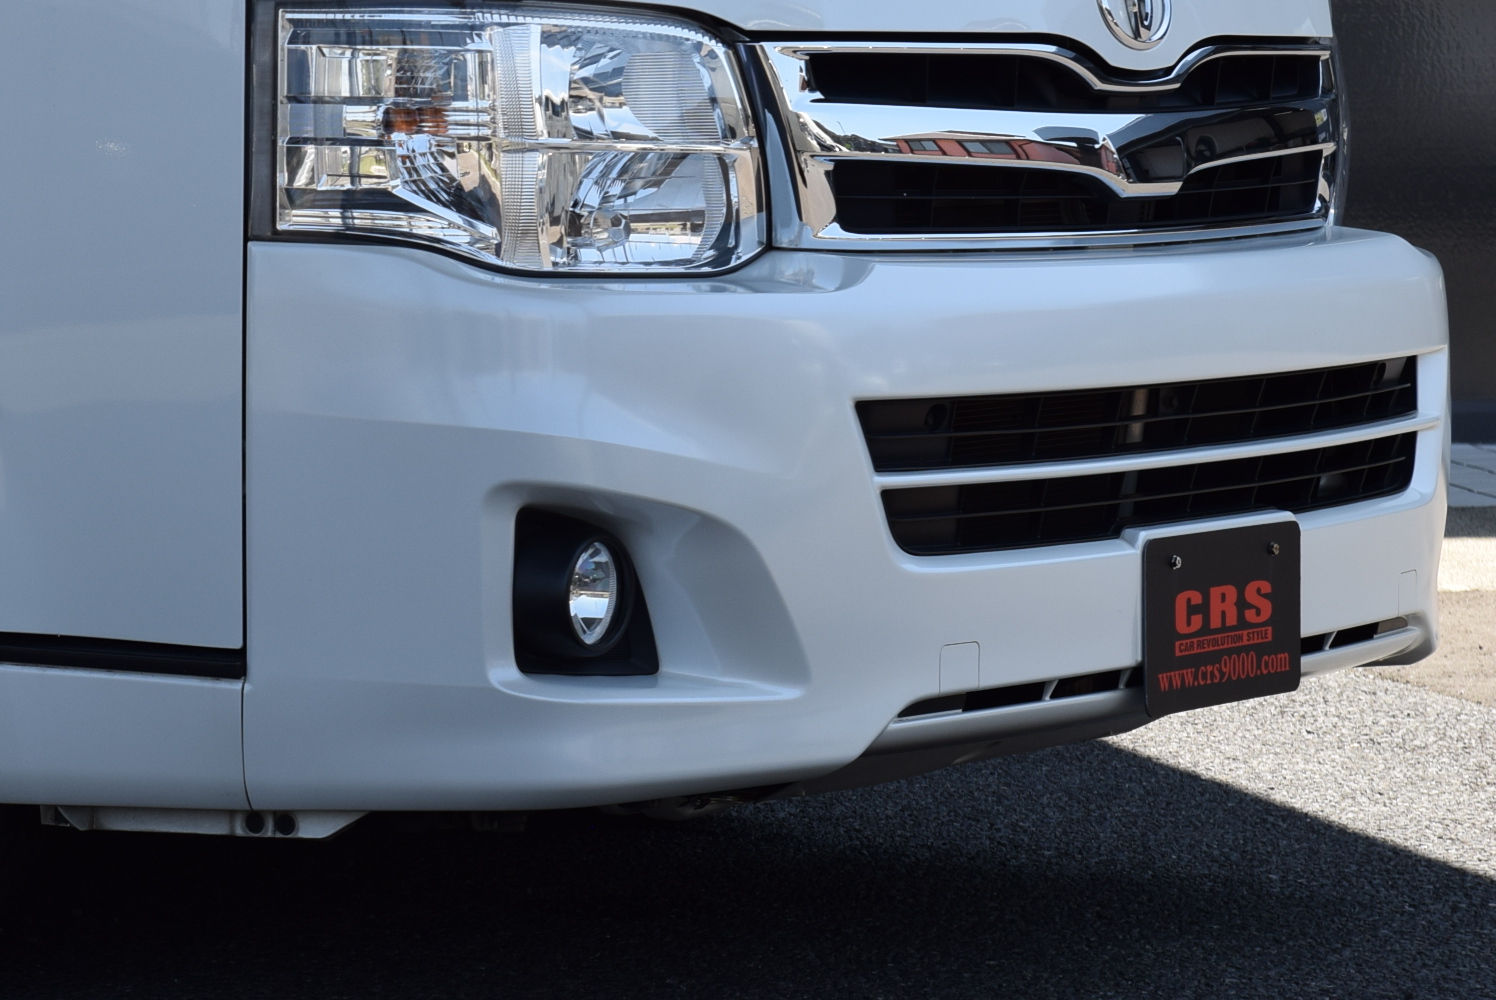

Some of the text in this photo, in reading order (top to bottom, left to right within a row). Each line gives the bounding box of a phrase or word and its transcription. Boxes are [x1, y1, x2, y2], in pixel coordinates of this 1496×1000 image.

[1175, 580, 1272, 634] CRS
[1178, 629, 1269, 653] CAR REVOLUTION STYLE
[1158, 651, 1290, 692] www.crs9000.com
